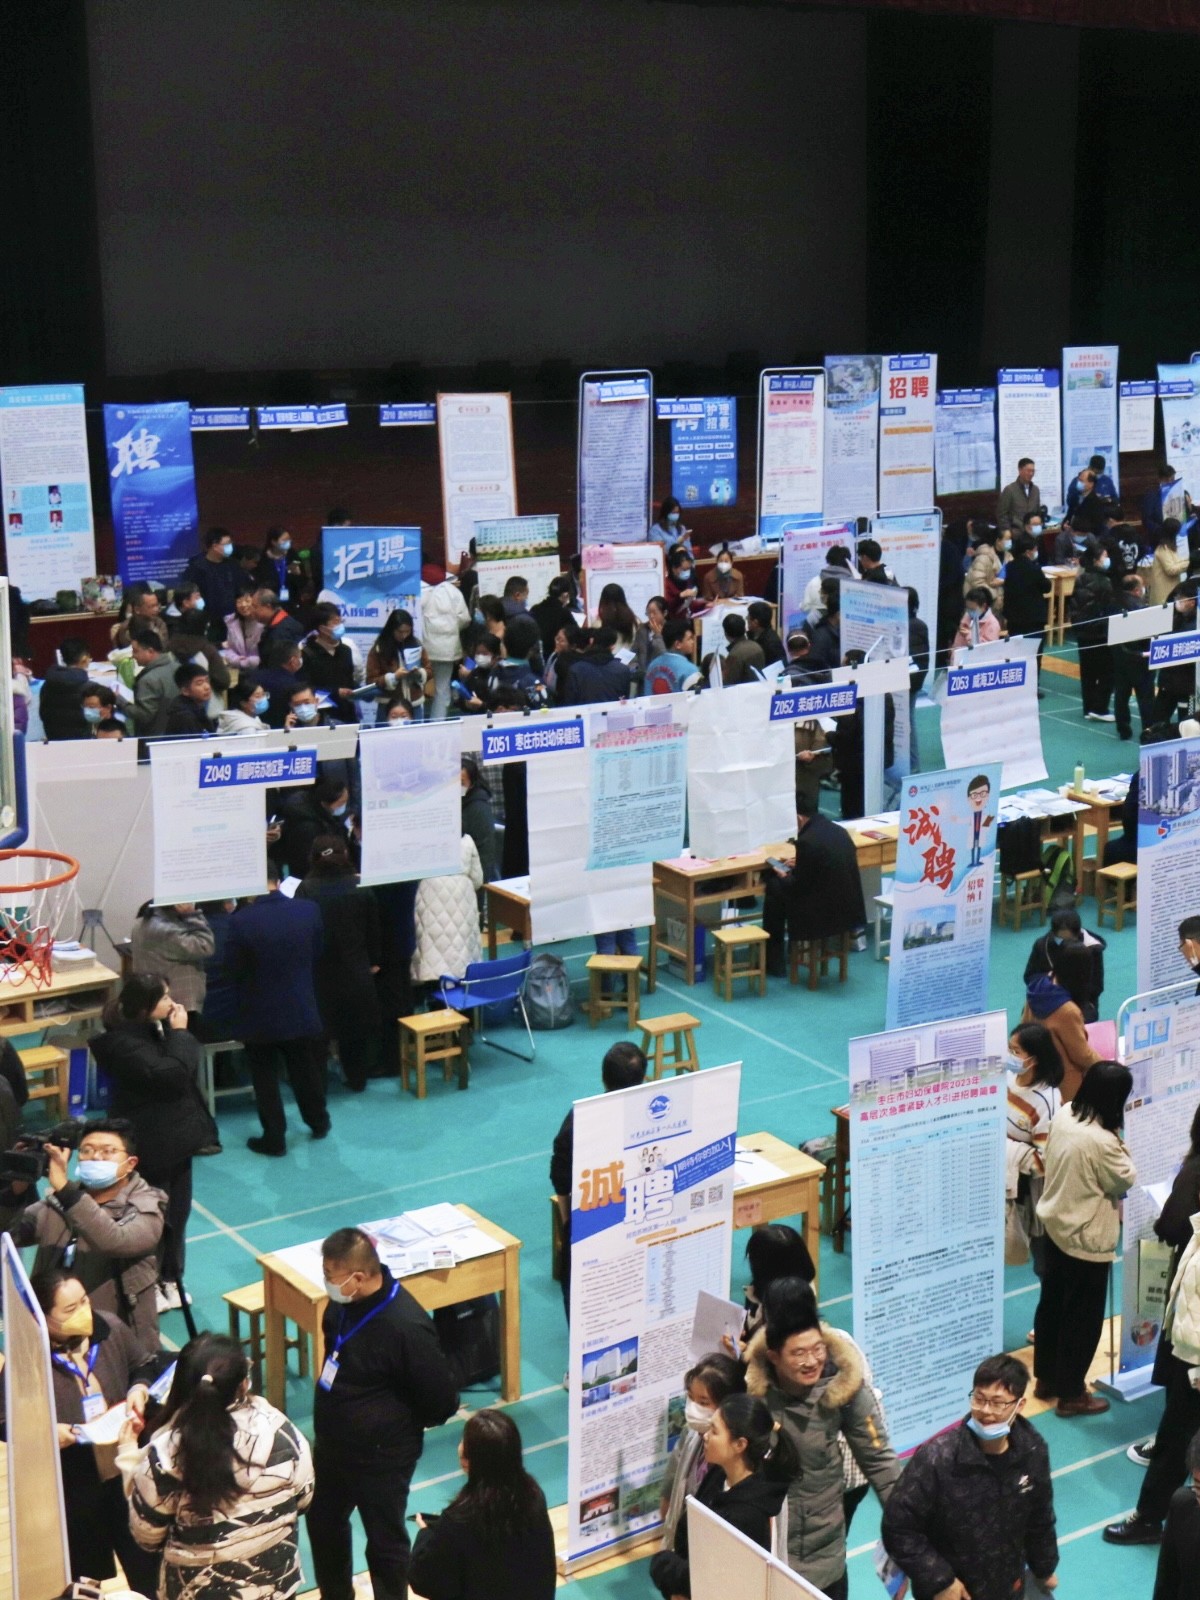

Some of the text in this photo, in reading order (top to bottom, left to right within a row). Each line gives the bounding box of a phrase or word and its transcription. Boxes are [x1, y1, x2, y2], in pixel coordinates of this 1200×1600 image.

[889, 376, 929, 399] 招聘
[111, 428, 161, 478] 聘
[334, 535, 422, 589] 招聘
[1152, 645, 1169, 661] Z054
[950, 667, 1024, 692] Z053 威海卫人民医院
[773, 691, 855, 716] Z052 荣成市人民医院
[486, 735, 511, 754] Z051
[514, 726, 582, 751] 枣庄市妇幼保健院
[204, 757, 313, 783] Z049 新疆阿克苏地区第一人民医院
[859, 1085, 998, 1121] 高层次急需紧缺人才引进招聘简章
[877, 1076, 981, 1106] 枣庄市妇幼保健院2023年
[678, 1140, 730, 1173] 期待你的加入
[579, 1160, 676, 1226] 诚聘
